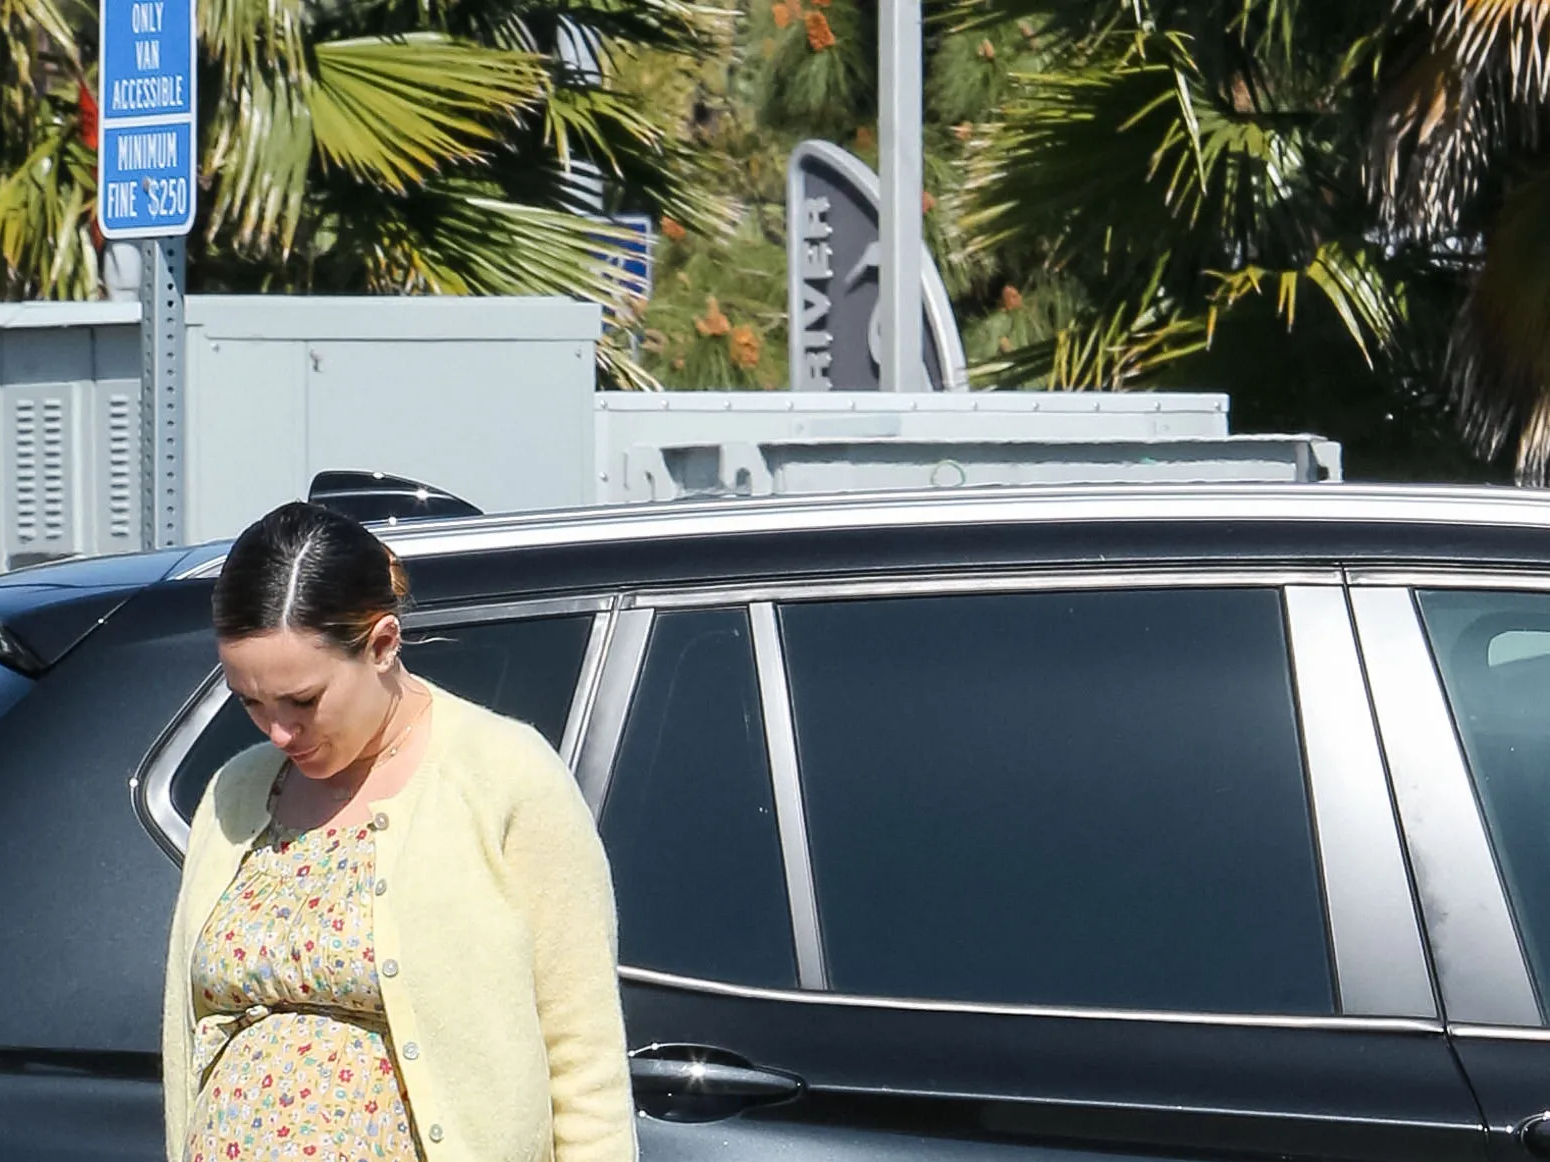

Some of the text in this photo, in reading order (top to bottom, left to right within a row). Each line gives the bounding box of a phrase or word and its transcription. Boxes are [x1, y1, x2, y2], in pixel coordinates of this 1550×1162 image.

[131, 2, 165, 34] ONLY
[135, 40, 160, 71] VAN
[112, 76, 184, 110] ACCESSIBLE
[117, 132, 177, 171] MINIMUM
[108, 177, 187, 219] FINE $250
